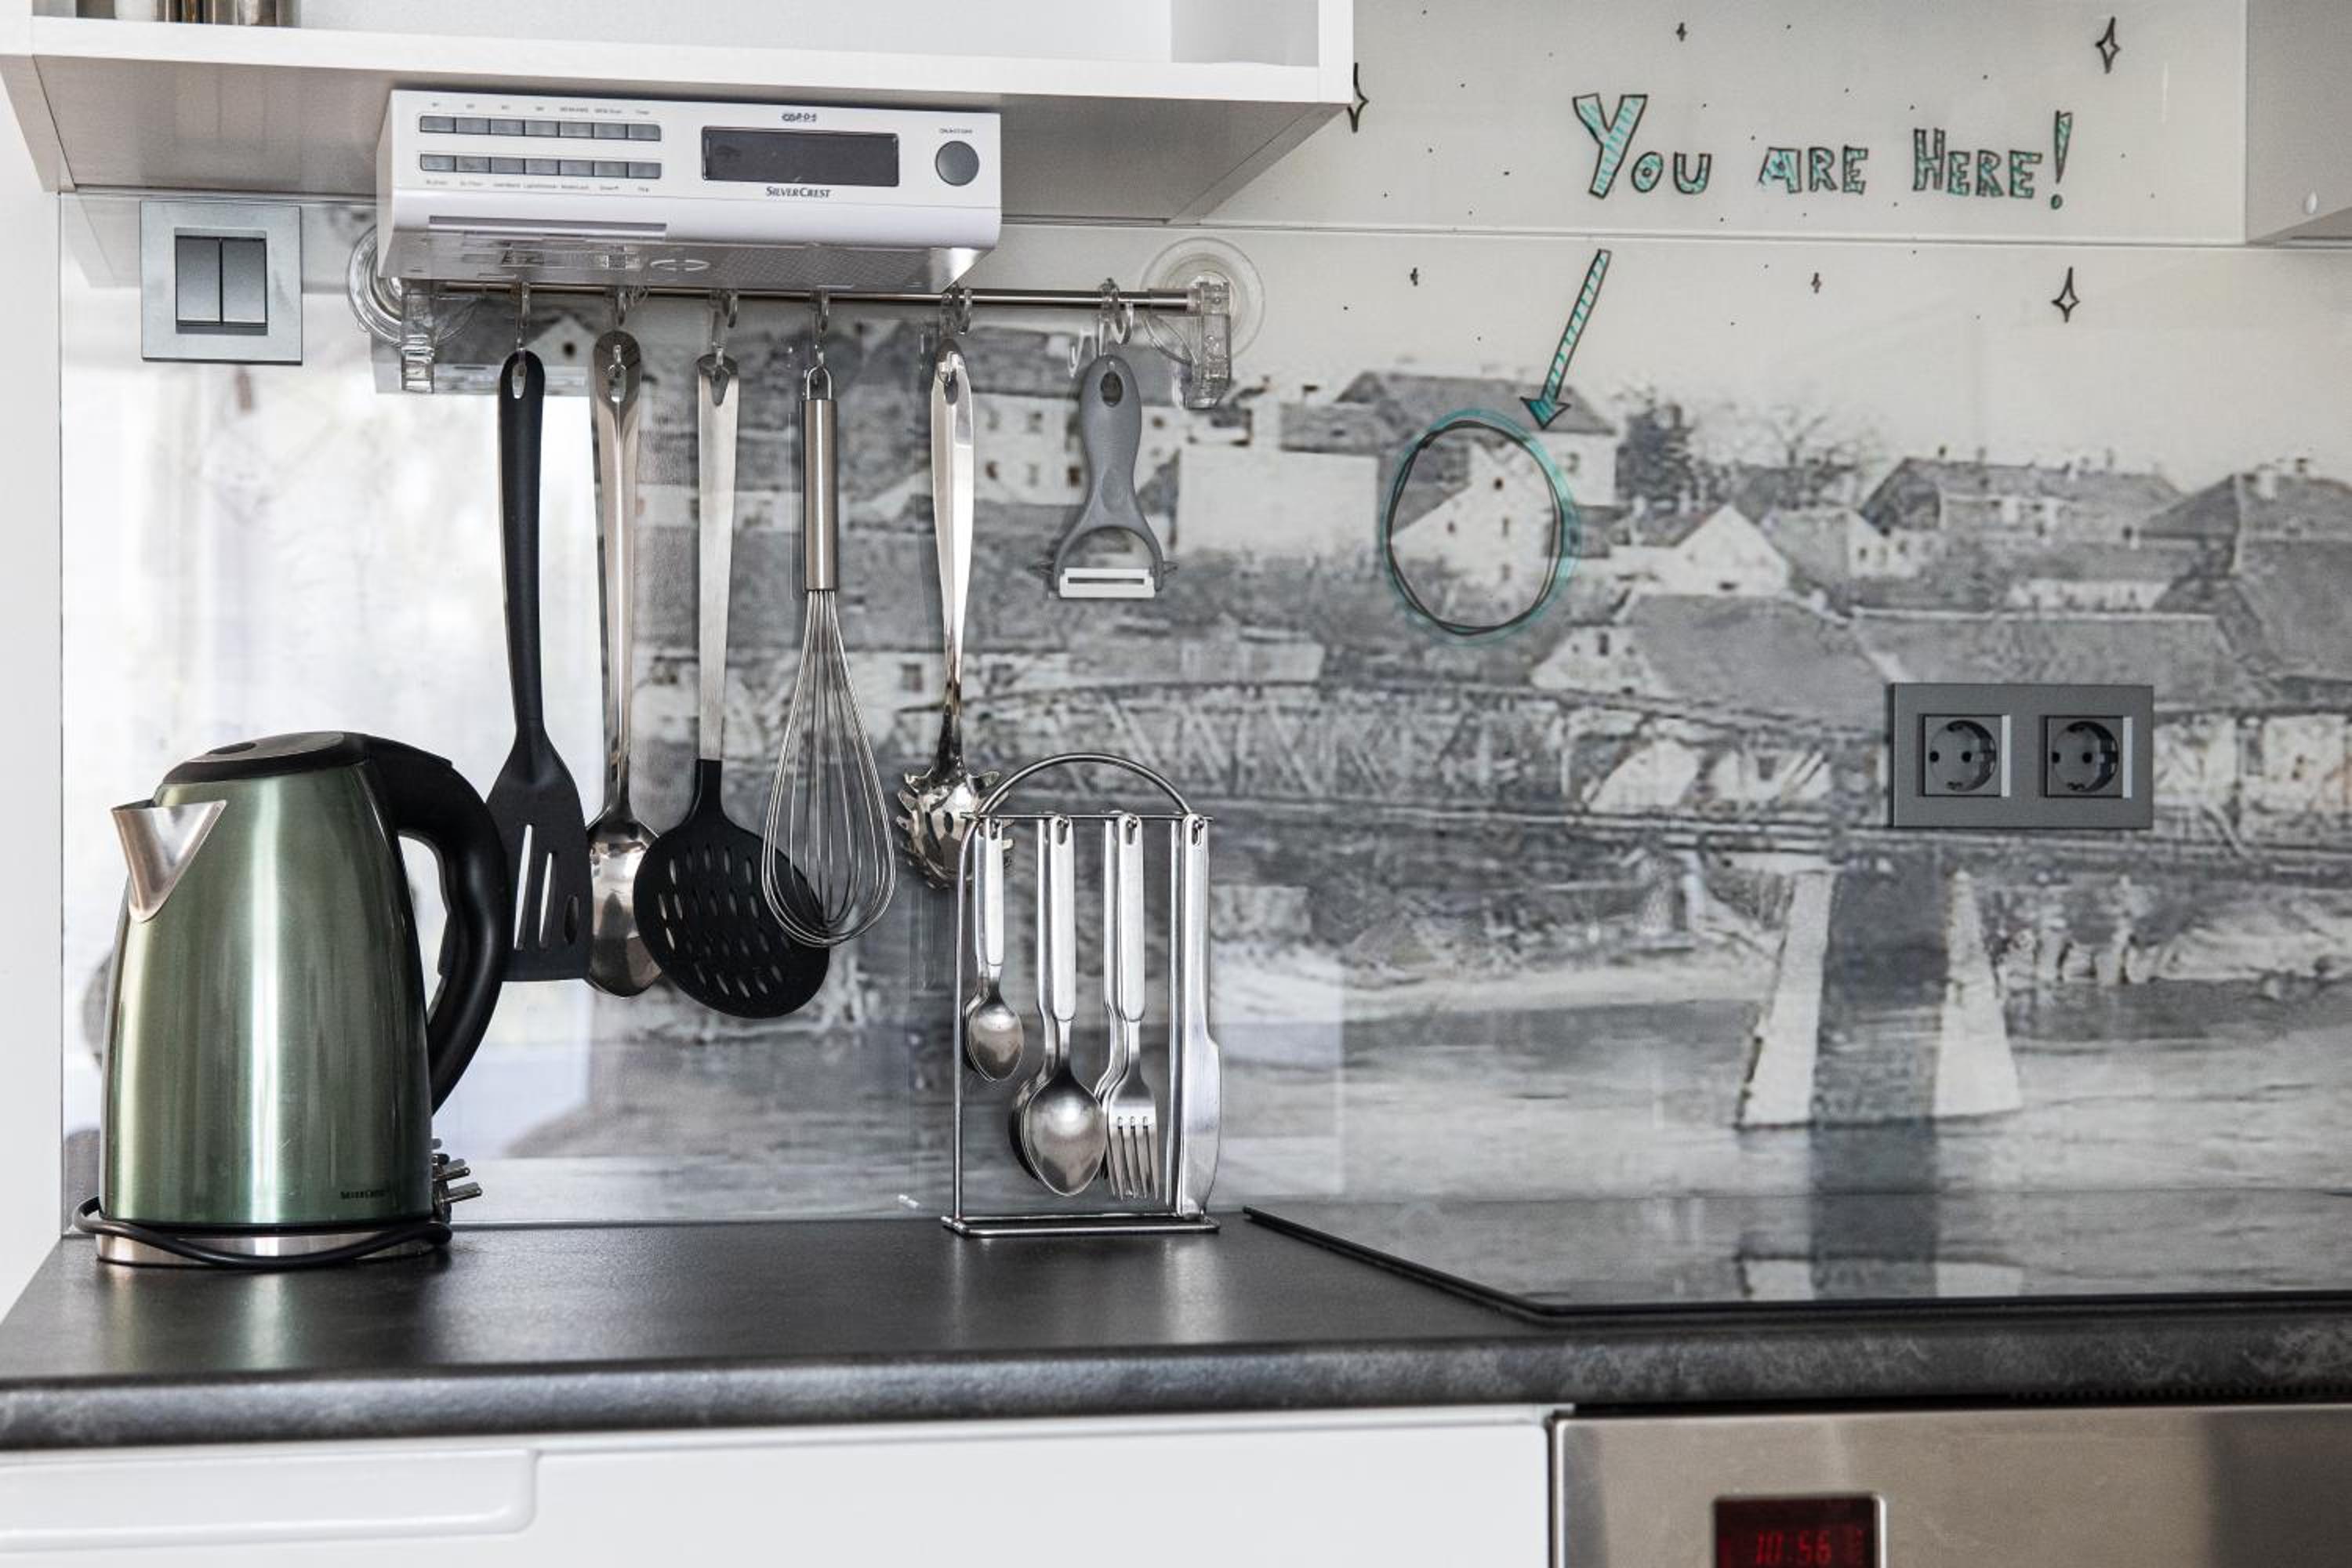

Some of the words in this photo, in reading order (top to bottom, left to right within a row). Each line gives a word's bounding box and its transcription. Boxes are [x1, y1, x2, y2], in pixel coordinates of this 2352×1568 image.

[1572, 93, 1711, 200] YOU
[1757, 145, 1870, 195] ARE
[1911, 109, 2072, 210] HERE!
